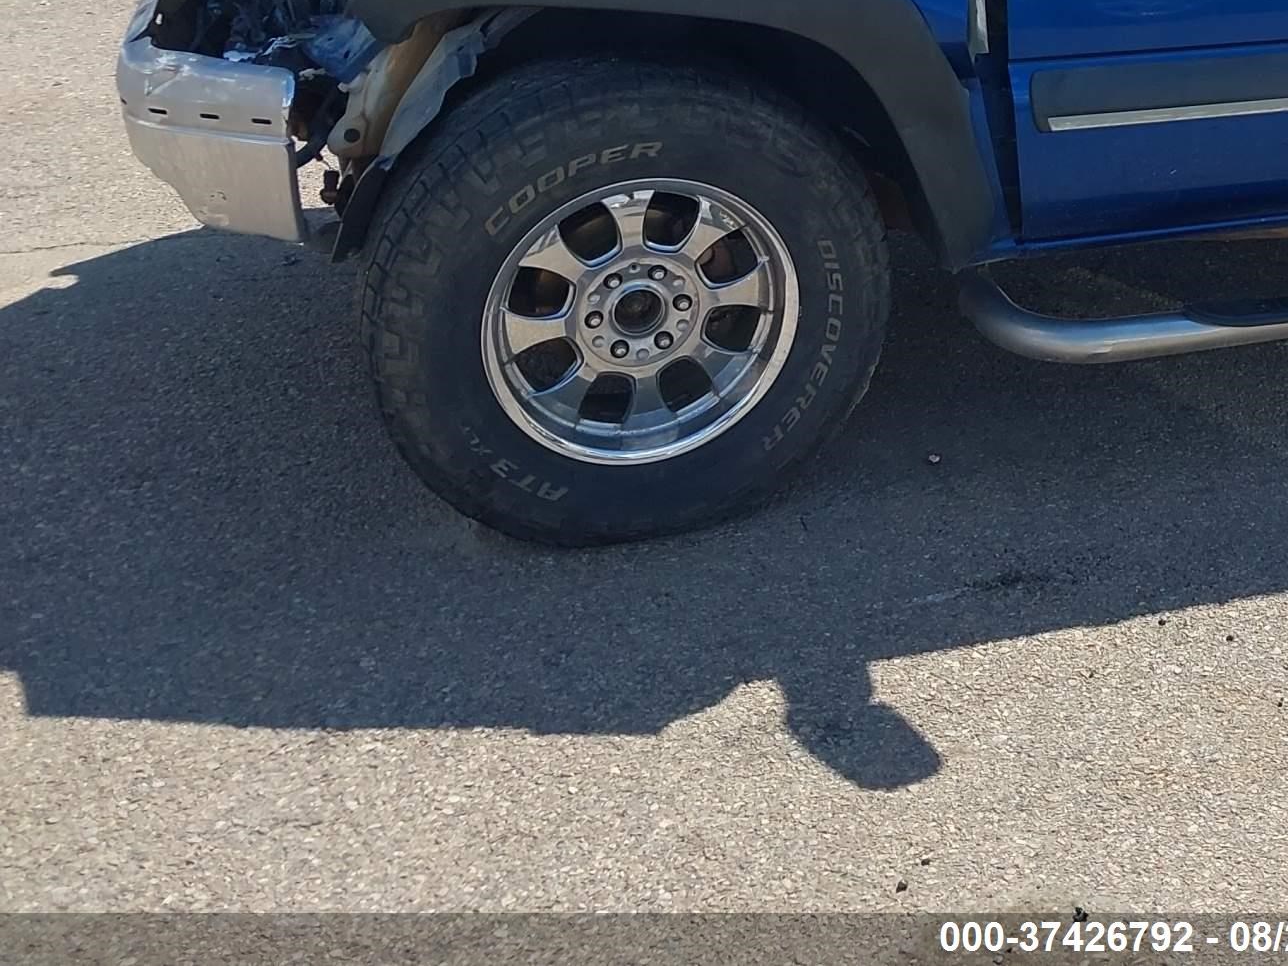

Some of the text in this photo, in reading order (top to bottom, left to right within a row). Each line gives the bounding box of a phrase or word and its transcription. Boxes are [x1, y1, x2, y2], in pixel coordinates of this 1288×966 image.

[485, 141, 662, 236] COOPER
[761, 239, 844, 451] DISCOVERER
[489, 458, 569, 502] AT3
